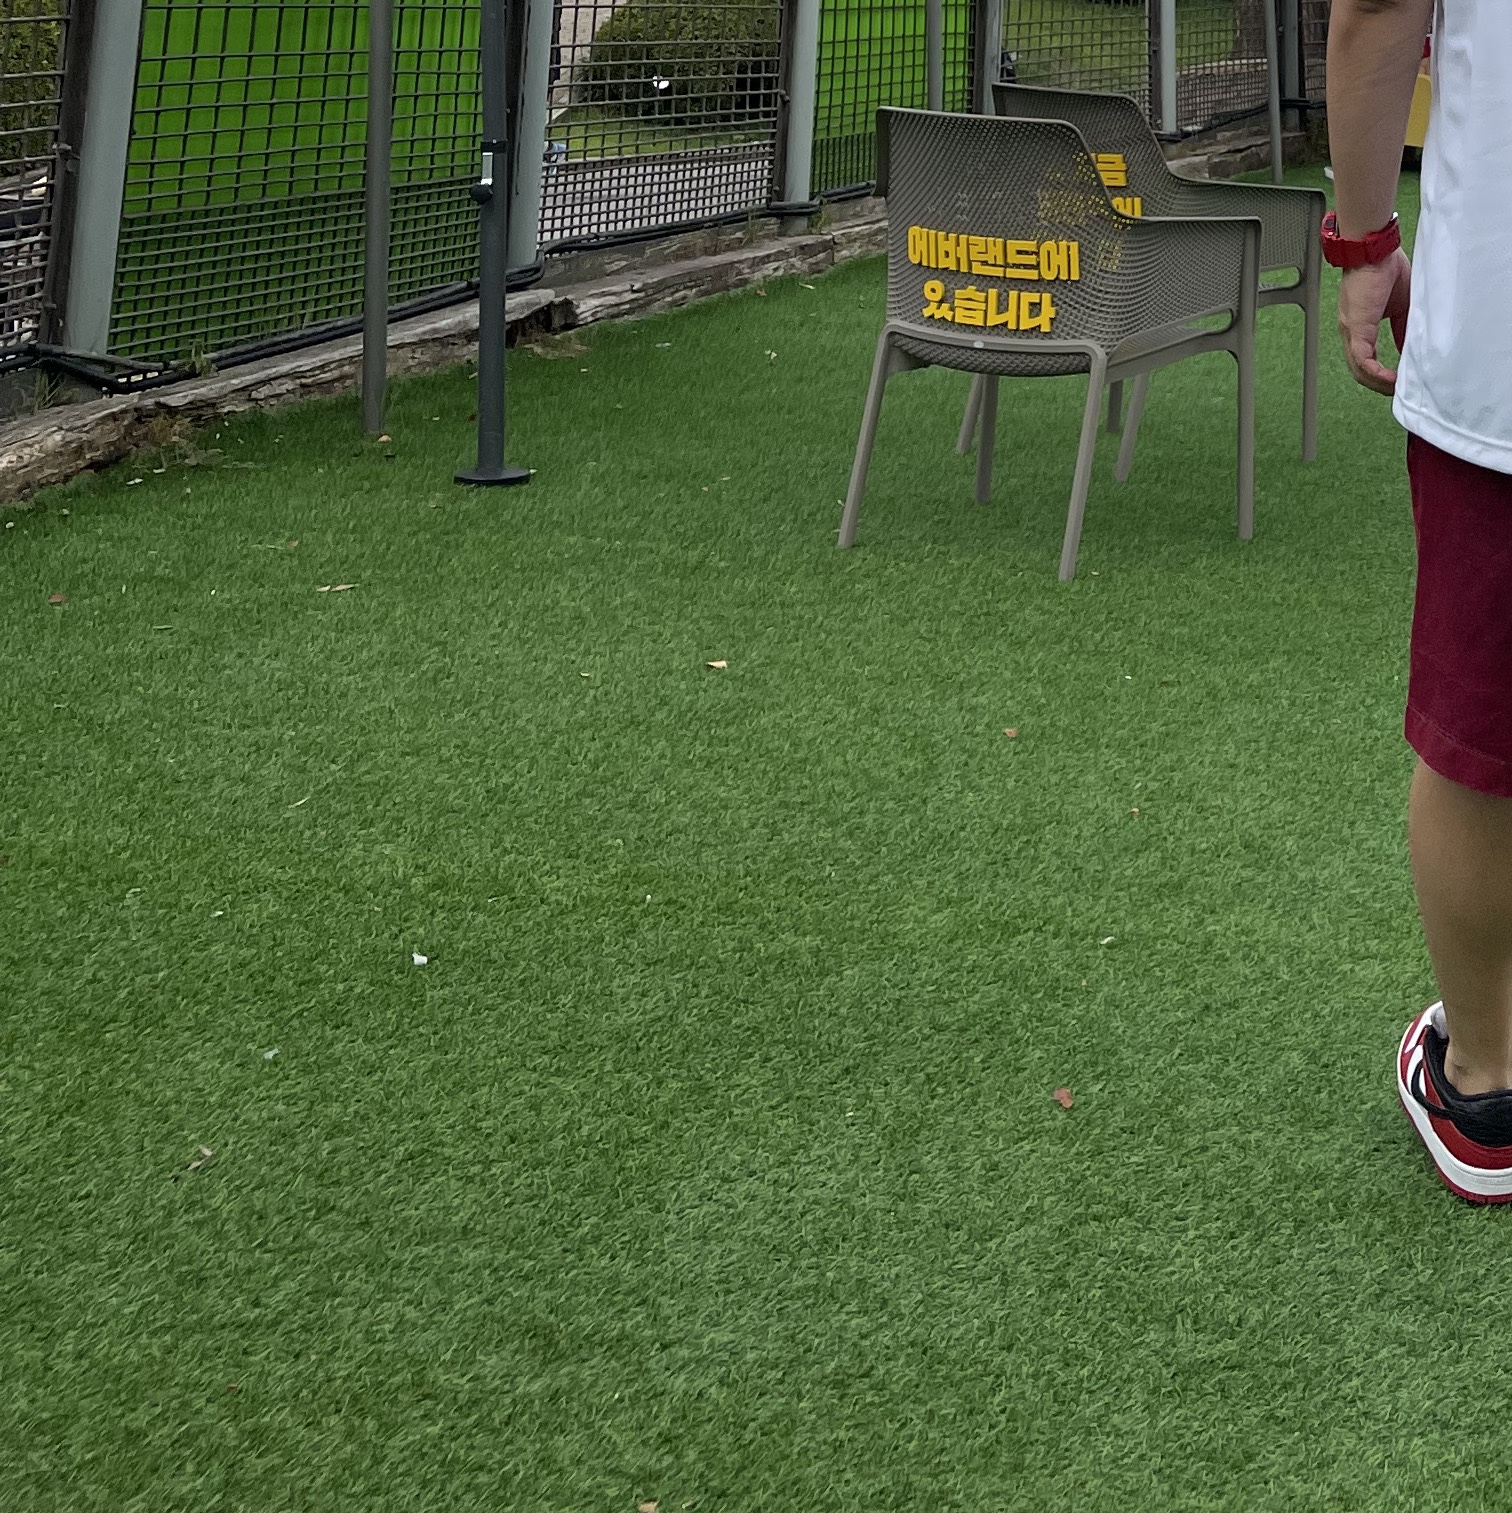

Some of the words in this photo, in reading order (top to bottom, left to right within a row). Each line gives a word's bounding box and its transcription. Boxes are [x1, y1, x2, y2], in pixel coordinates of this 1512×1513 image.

[1091, 152, 1128, 187] 금
[908, 225, 1080, 281] 에버랜드에
[922, 279, 1057, 333] 있습니다
